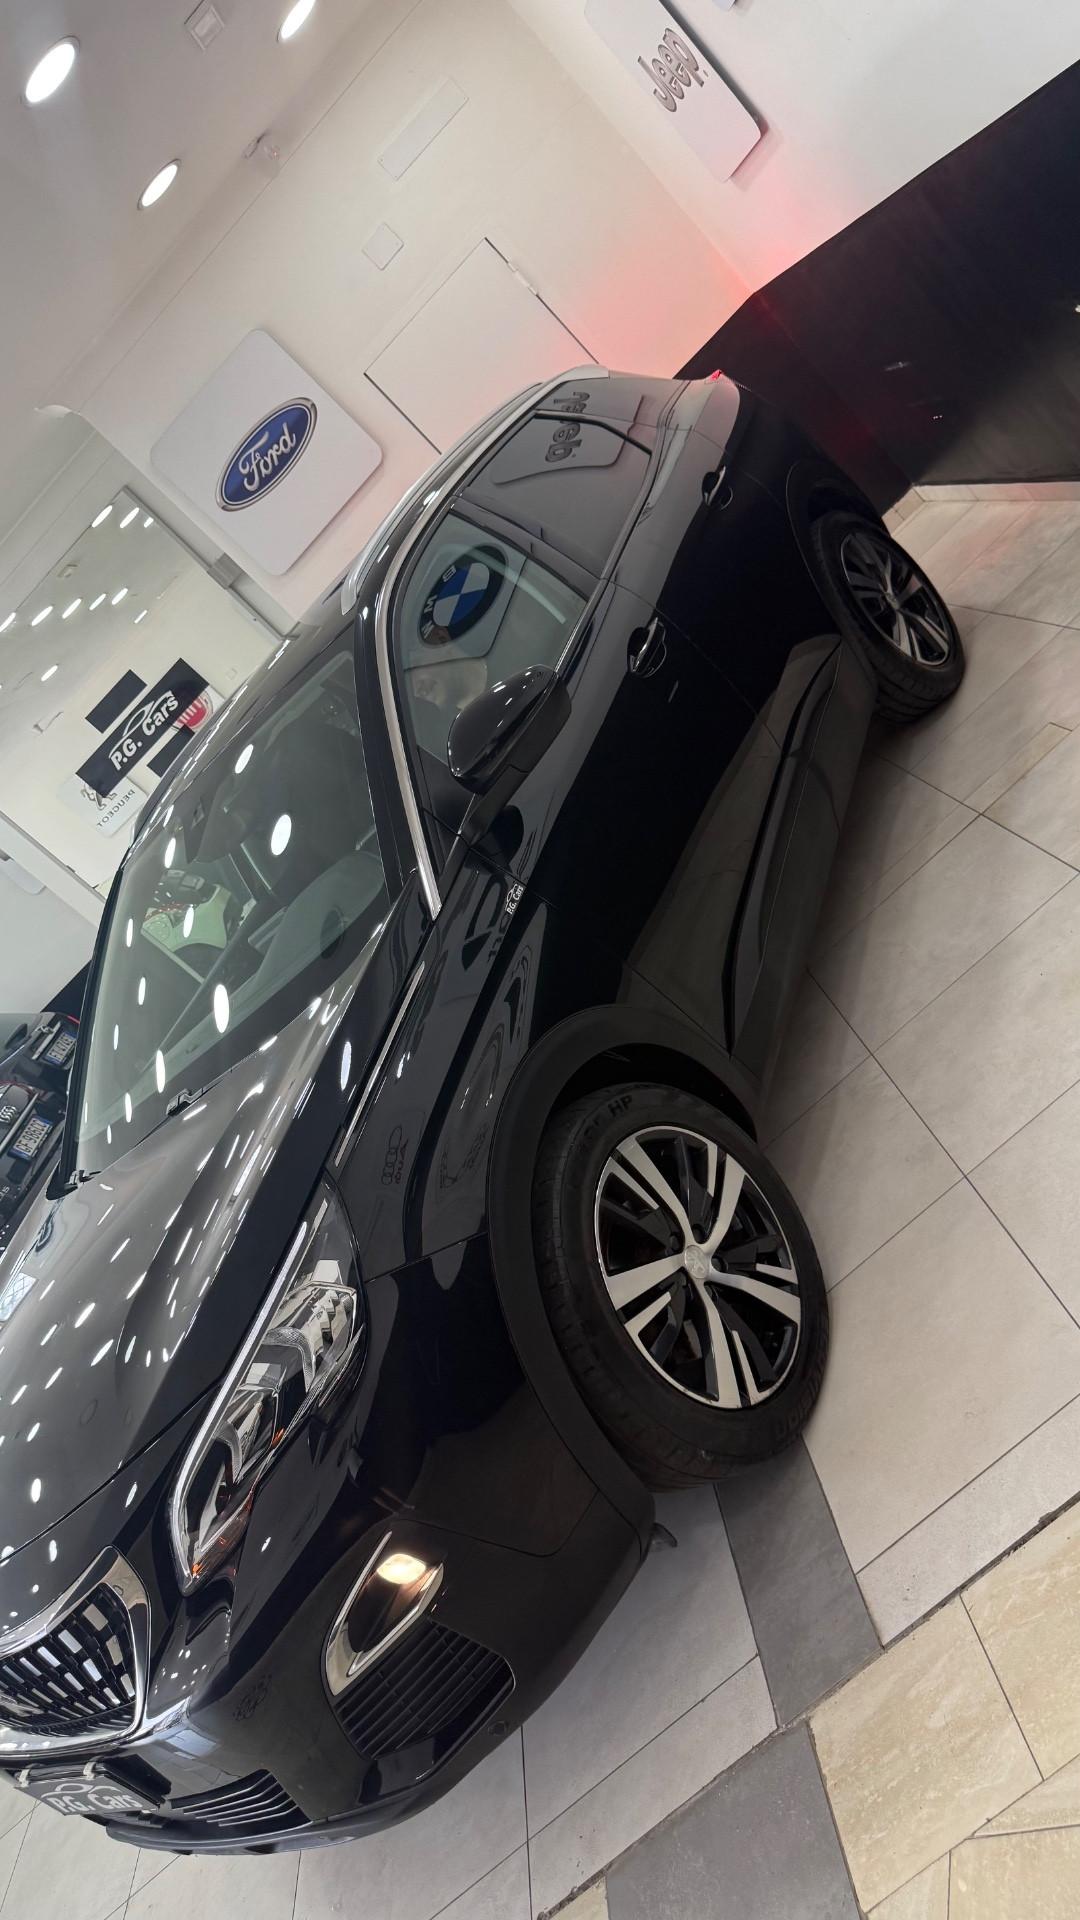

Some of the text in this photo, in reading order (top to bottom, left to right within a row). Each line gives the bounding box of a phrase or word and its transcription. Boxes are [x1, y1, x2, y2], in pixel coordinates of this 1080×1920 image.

[637, 27, 705, 113] Jeep
[238, 421, 297, 492] Ford
[109, 693, 180, 772] P.G. Cars
[506, 884, 524, 915] P.G. Cars
[607, 1094, 633, 1118] HP
[46, 1792, 143, 1813] P.G. Cars
